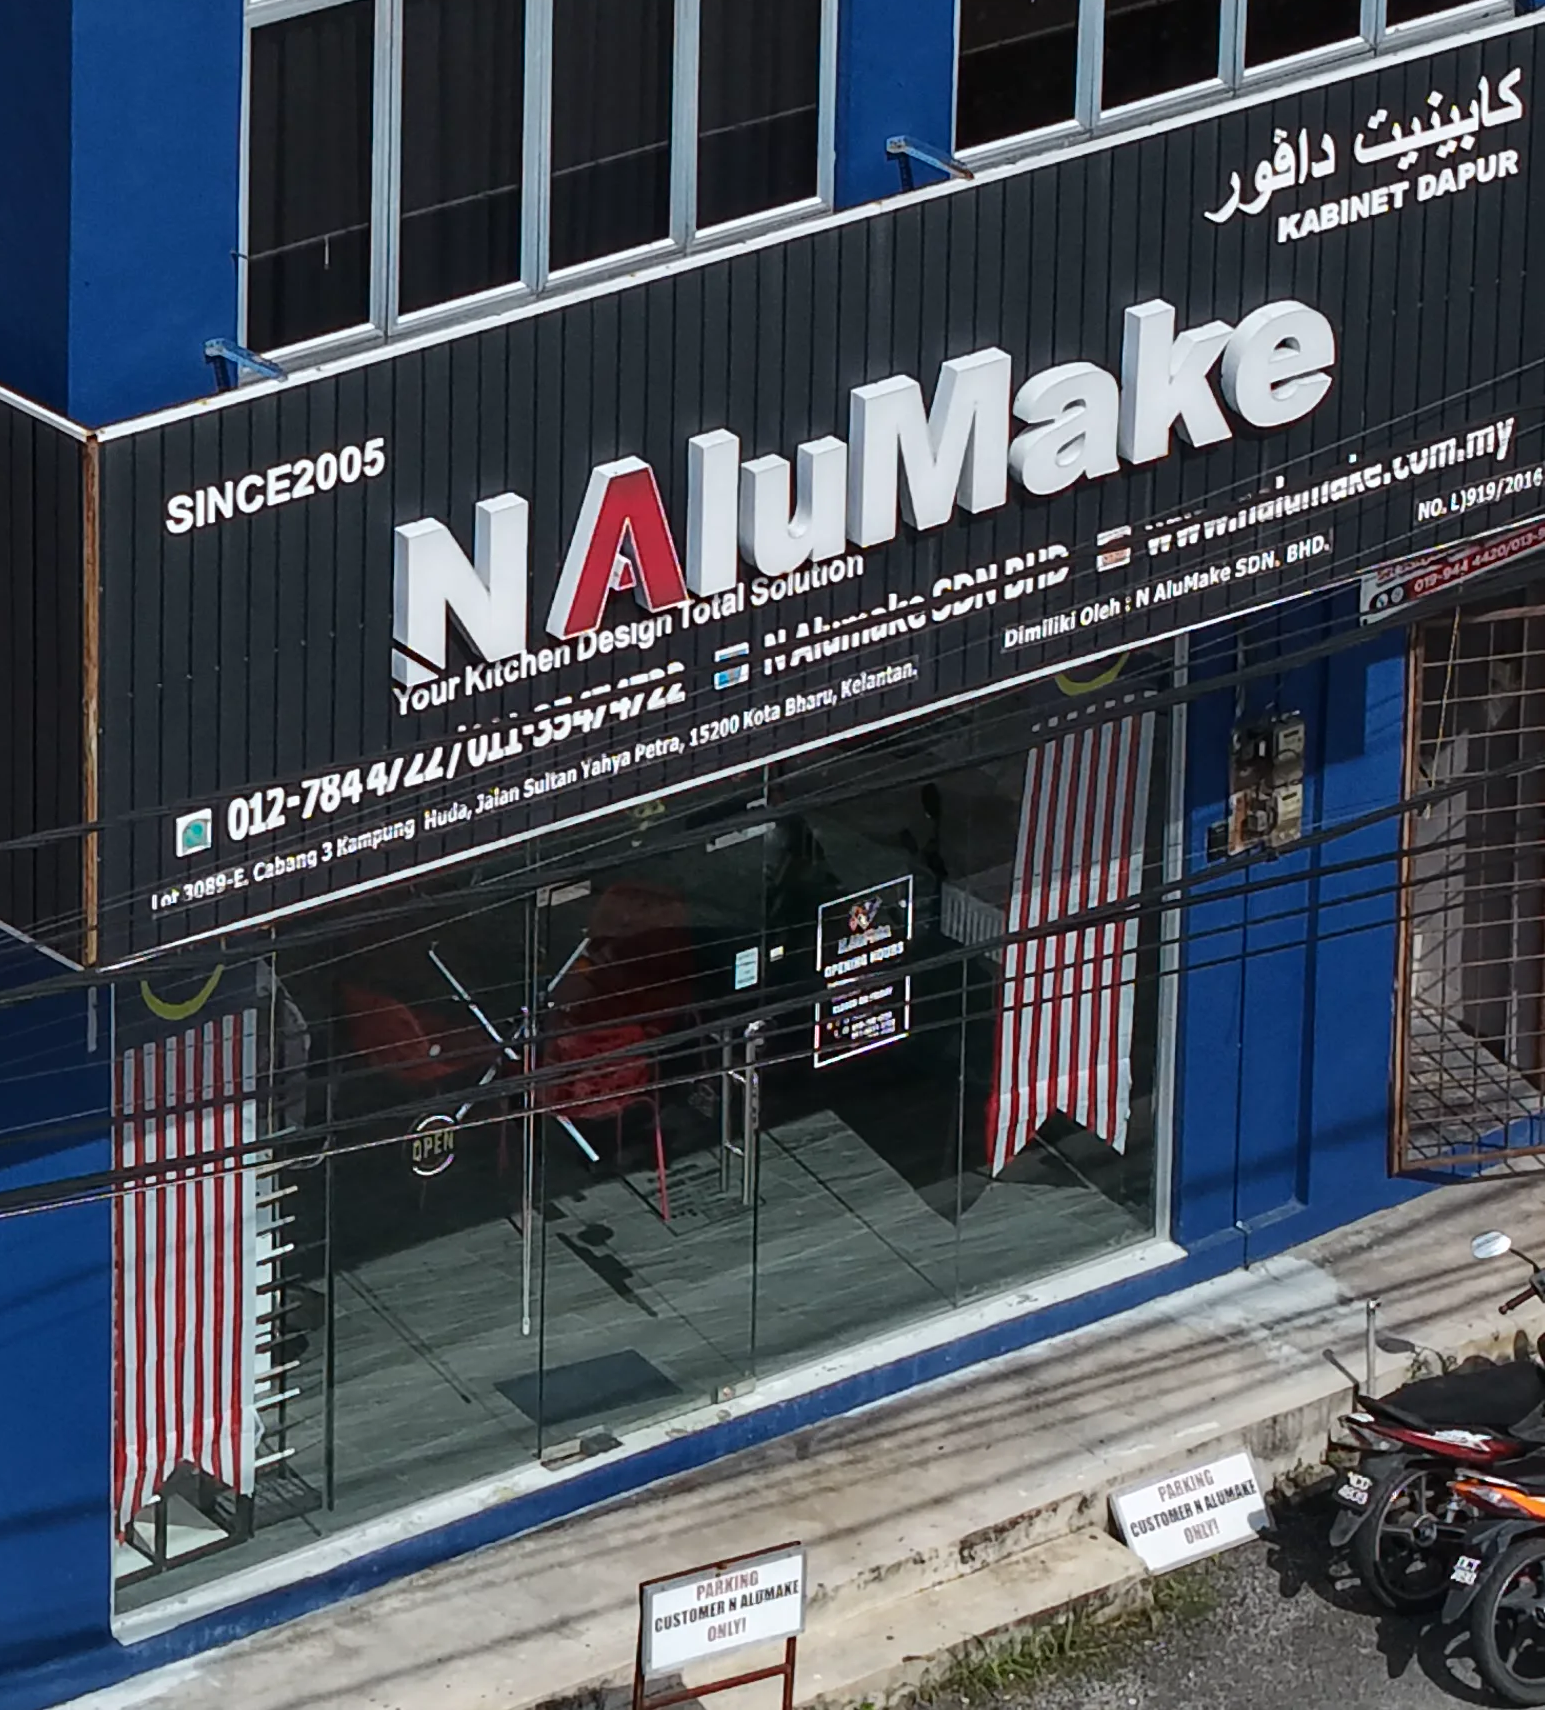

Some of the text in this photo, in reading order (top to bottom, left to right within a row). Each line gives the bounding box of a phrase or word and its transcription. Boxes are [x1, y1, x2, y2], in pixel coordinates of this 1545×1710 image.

[1278, 149, 1519, 244] KABINET DAPUR
[166, 437, 386, 535] SINCE2005
[1004, 609, 1076, 649] Dimiliki
[1079, 598, 1121, 626] Oleh
[1135, 588, 1150, 609] N
[1153, 563, 1231, 603] AluMake
[1285, 535, 1331, 564] BHD.
[392, 553, 865, 716] Your Kitchen Design Total Solution
[253, 849, 318, 883] Cabang
[321, 841, 333, 863] 3
[336, 818, 416, 858] Kampung
[475, 786, 520, 815] Jalan
[523, 767, 577, 798] Sultan
[580, 750, 631, 779] Yahya
[634, 736, 686, 762] Petra,
[689, 714, 740, 747] 15200
[743, 705, 781, 730] Kota
[785, 688, 838, 718] Bharu,
[412, 1130, 454, 1162] OPEN
[1129, 1478, 1257, 1538] CUSTOMER N ALUMAKE
[1158, 1469, 1215, 1502] PARKING
[654, 1579, 799, 1633] CUSTOMER N ALUMAKE
[696, 1570, 759, 1601] PARKING
